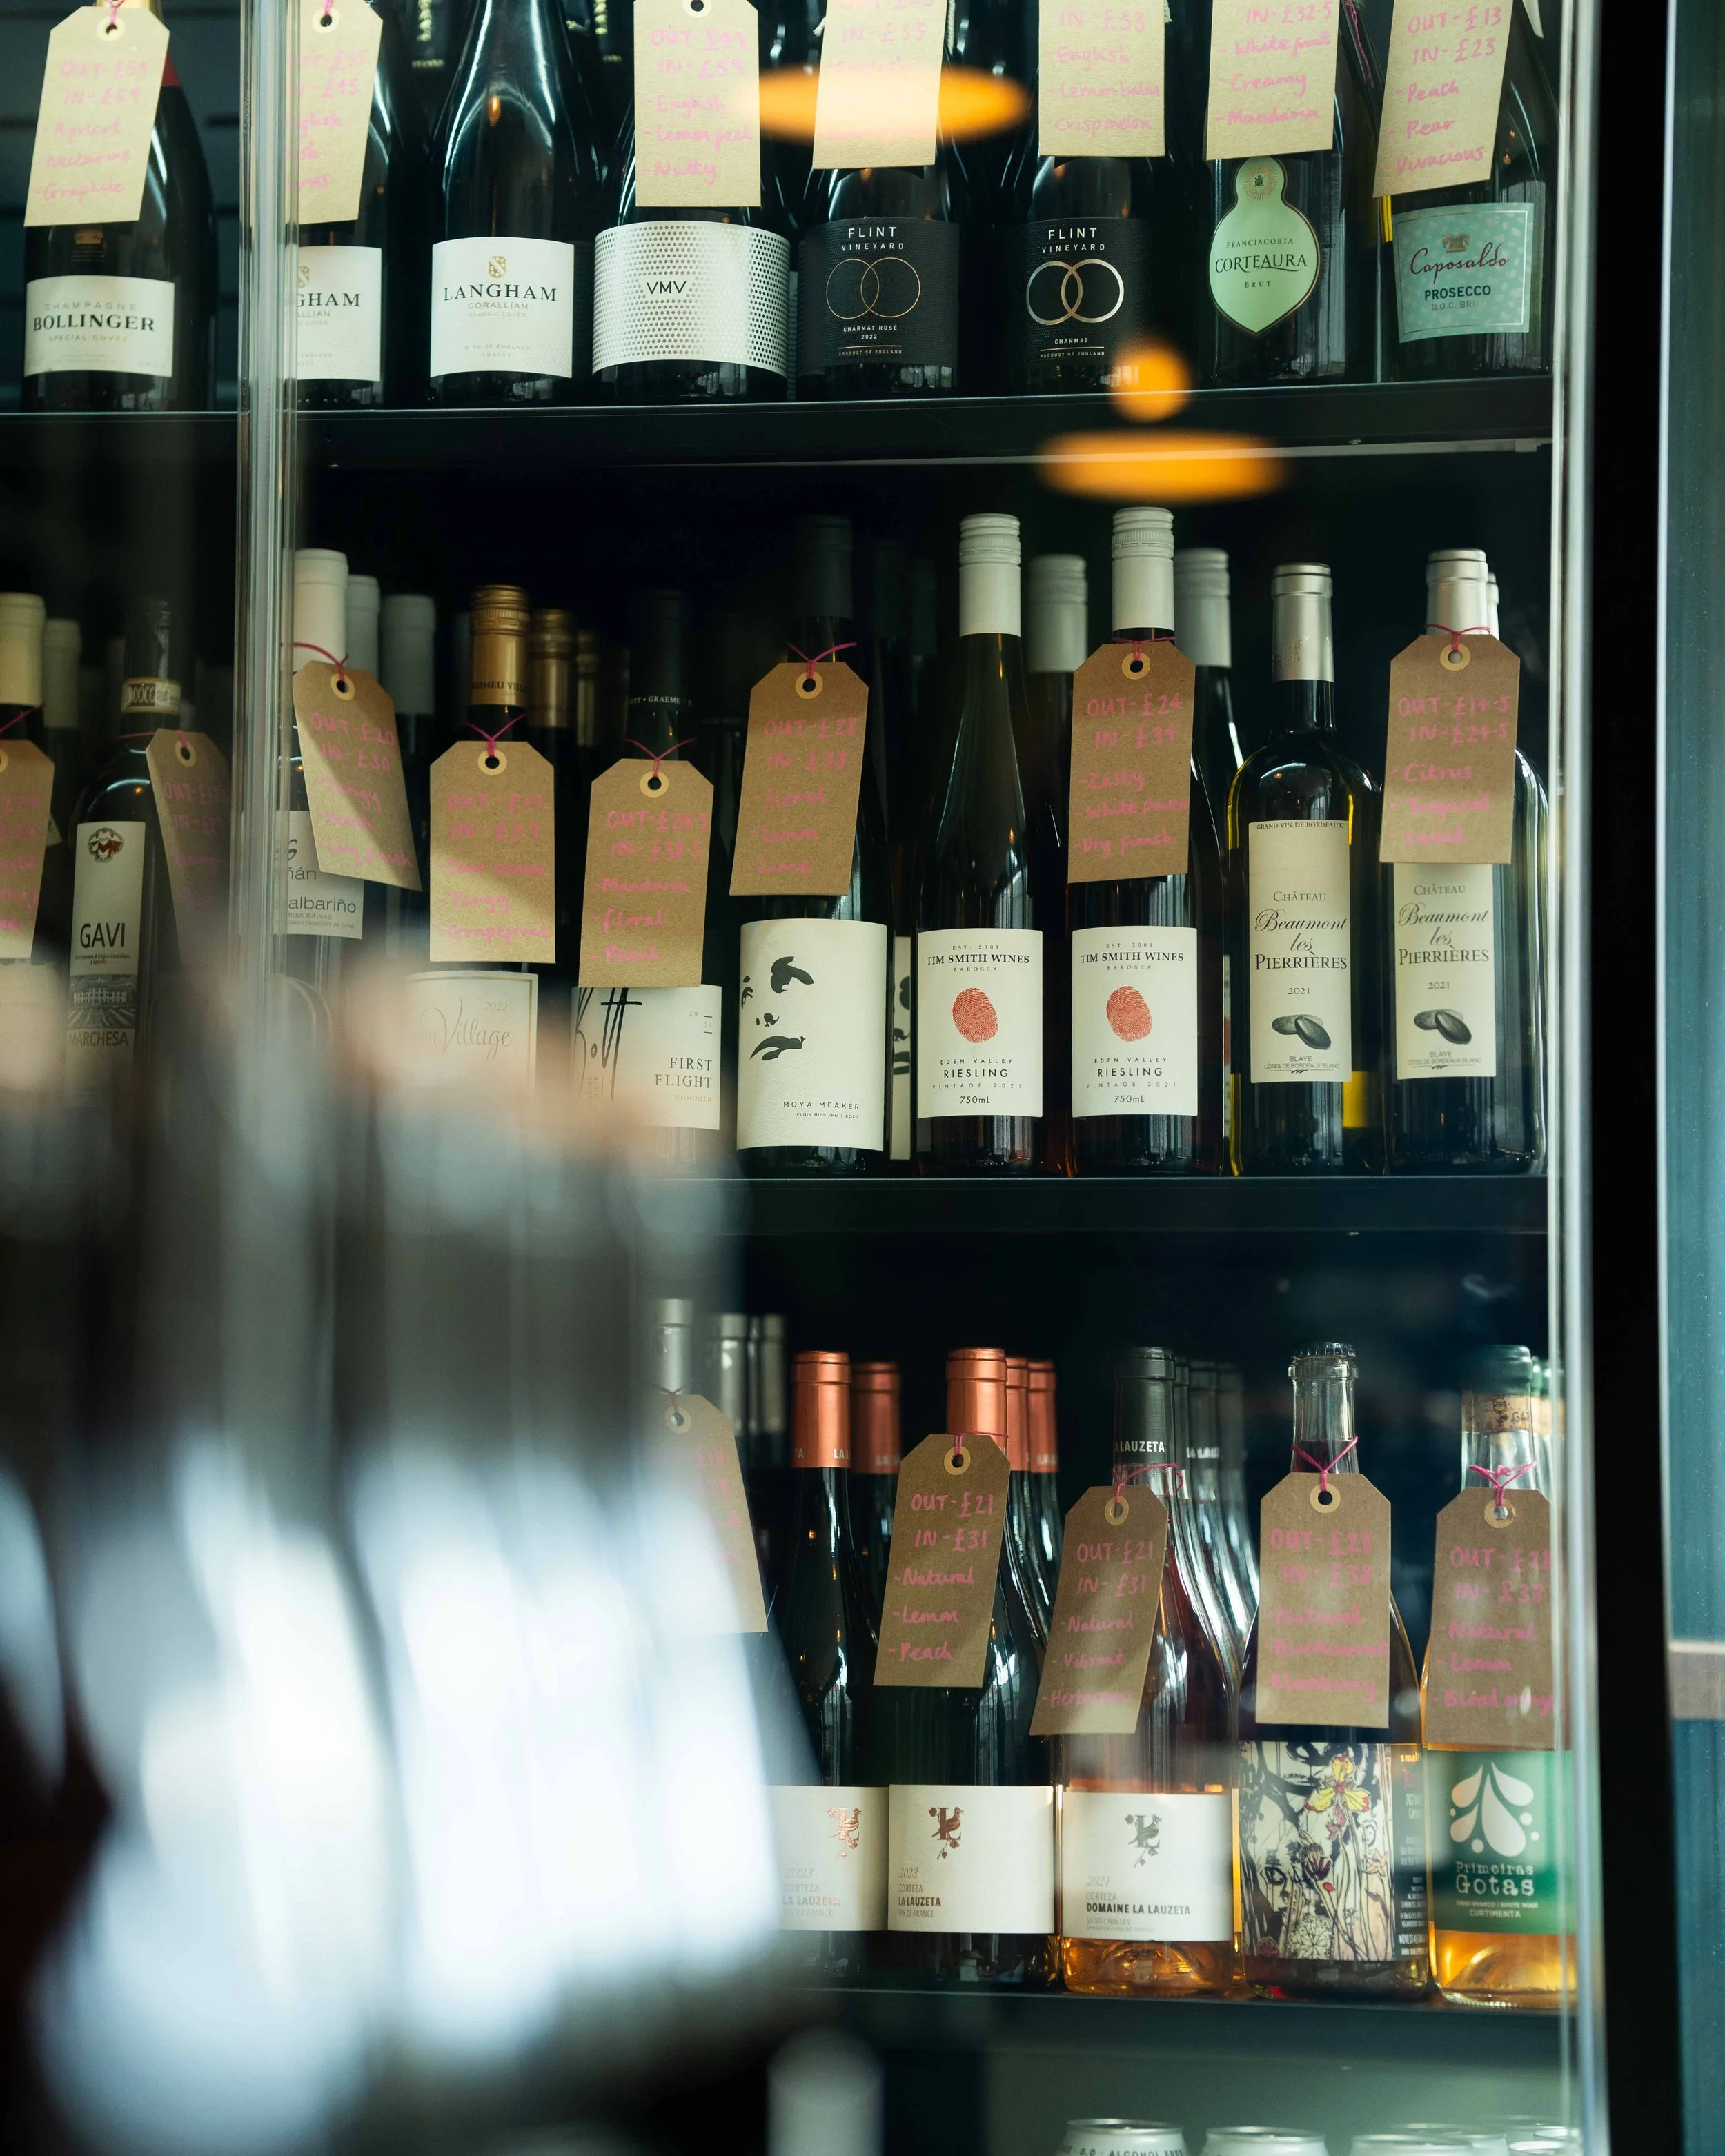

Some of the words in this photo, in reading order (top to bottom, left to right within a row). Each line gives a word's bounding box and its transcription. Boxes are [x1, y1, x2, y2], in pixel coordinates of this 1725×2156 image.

[848, 226, 897, 239] FLINT
[1048, 228, 1097, 241] FLINT
[842, 242, 905, 251] VINEYARD
[1042, 244, 1105, 253] VINEYARD
[1227, 238, 1293, 248] FRANCIACORTA
[1215, 253, 1308, 273] CORTEAURA
[1410, 242, 1509, 284] Caposaldo
[444, 284, 558, 301] LANGHAM
[646, 281, 687, 295] VMV
[1425, 285, 1491, 301] PROSECCO
[45, 301, 137, 311] CHAMPAGNE
[297, 293, 361, 307] GHAM
[468, 301, 528, 310] CORALLIAN
[33, 313, 155, 332] BOLLINGER
[648, 695, 681, 704] GRAEME
[1273, 891, 1326, 902] CHÂTEAU
[1414, 884, 1466, 896] CHÂTEAU
[288, 896, 357, 913] albariño
[1254, 909, 1348, 931] Beaumont
[1398, 903, 1488, 926] Beaumont
[80, 922, 126, 949] GAVI
[1430, 927, 1452, 946] les
[1290, 933, 1313, 952] les
[927, 955, 945, 965] TIM
[948, 953, 987, 964] SMITH
[992, 953, 1030, 964] WINES
[1081, 954, 1098, 964] TIM
[1101, 952, 1141, 962] SMITH
[1145, 952, 1184, 962] WINES
[1254, 951, 1348, 971] PIERRIÈRES
[1399, 946, 1489, 965] PIERRIÈRES
[669, 1057, 712, 1071] FIRST
[943, 1069, 1009, 1078] RIESLING
[1098, 1067, 1163, 1078] RIESLING
[655, 1074, 712, 1089] FLIGHT
[960, 1095, 991, 1104] 750mL
[1114, 1094, 1145, 1104] 750mL
[819, 1102, 860, 1110] MEAKER
[1120, 1441, 1165, 1452] LAUZETA
[900, 1867, 918, 1879] 2023
[1456, 1861, 1533, 1875] Primeiras
[898, 1883, 923, 1892] CORTEZA
[1456, 1874, 1535, 1897] Gotas
[898, 1897, 906, 1906] LA
[907, 1897, 941, 1907] LAUZETA
[1086, 1903, 1130, 1914] DOMAINE
[1132, 1904, 1144, 1914] LA
[1147, 1905, 1190, 1915] LAUZETA
